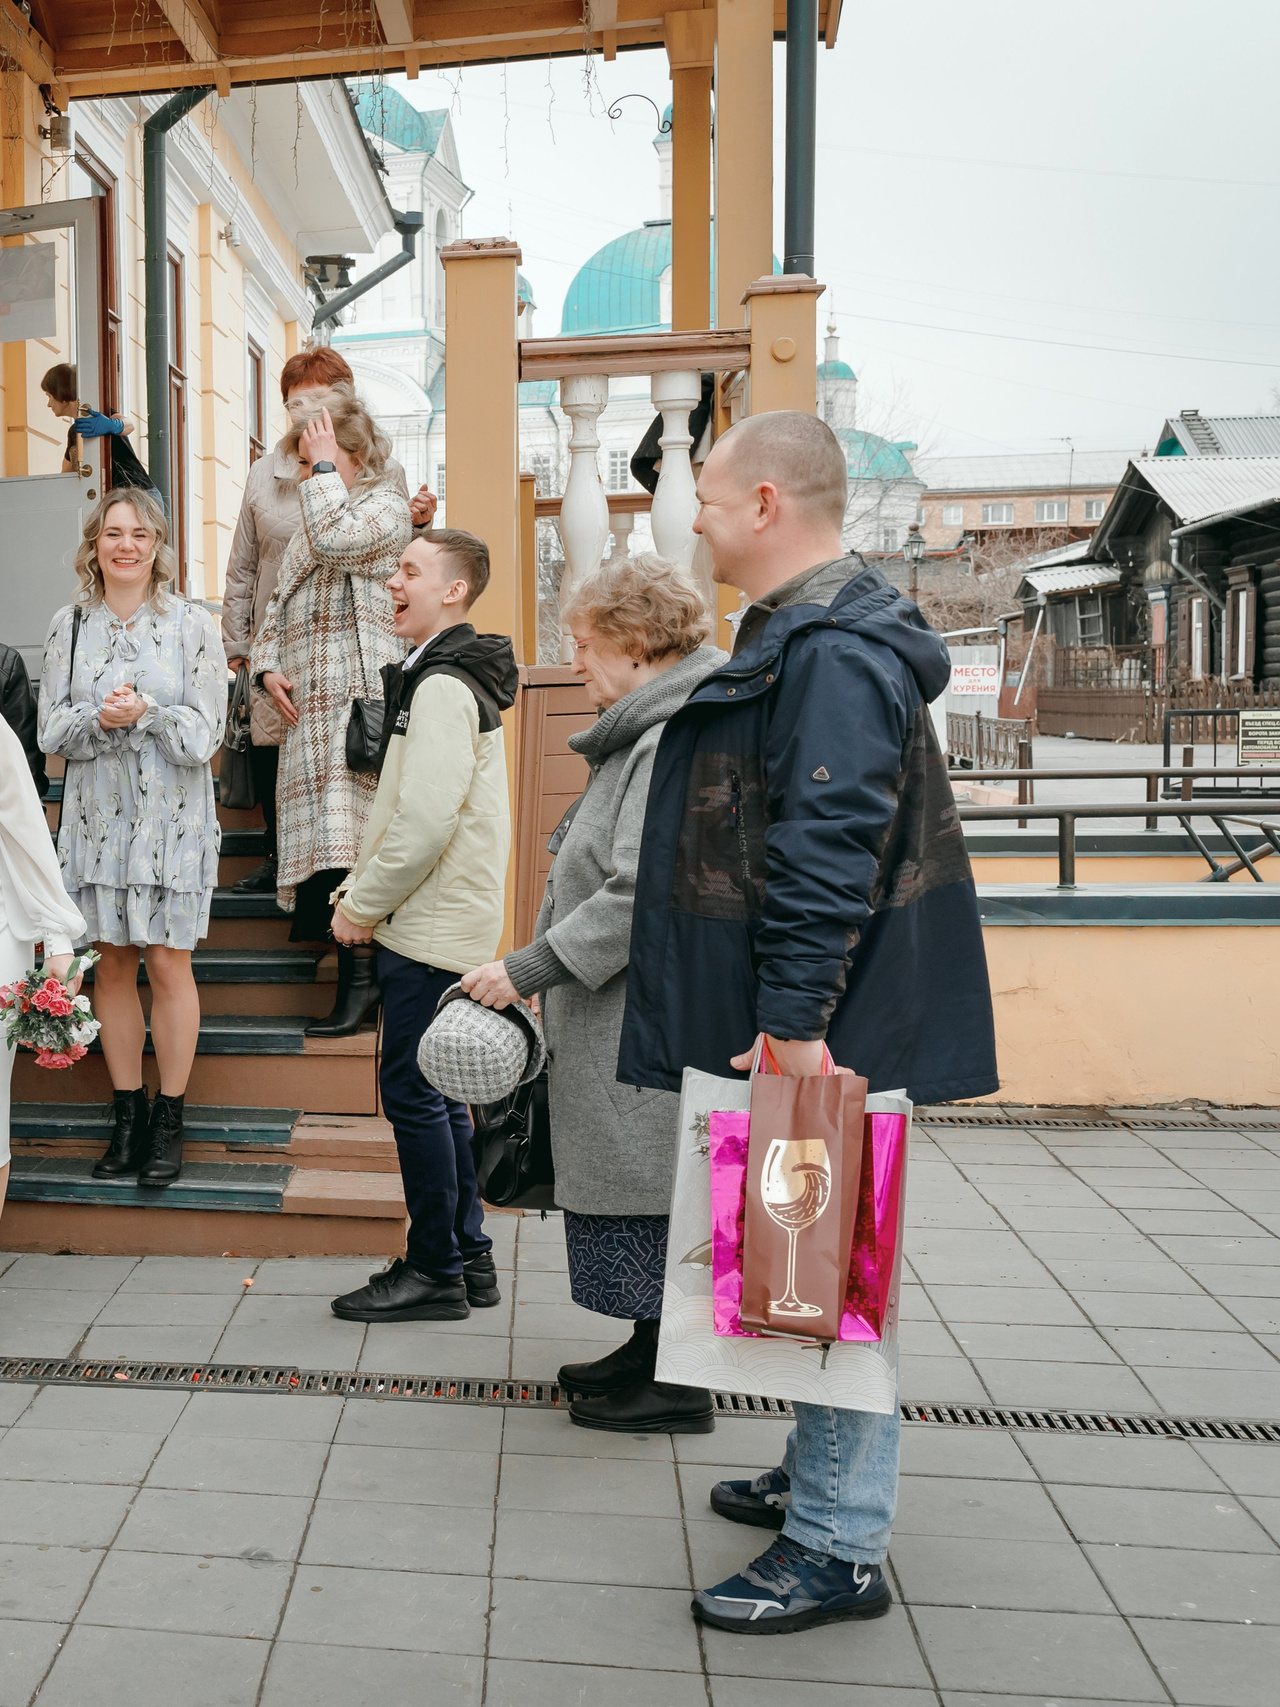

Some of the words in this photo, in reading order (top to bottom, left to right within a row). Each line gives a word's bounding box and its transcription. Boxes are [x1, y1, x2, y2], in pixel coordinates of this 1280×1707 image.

[954, 667, 997, 677] МЕСТО
[399, 710, 409, 718] THE
[741, 860, 751, 879] ONE
